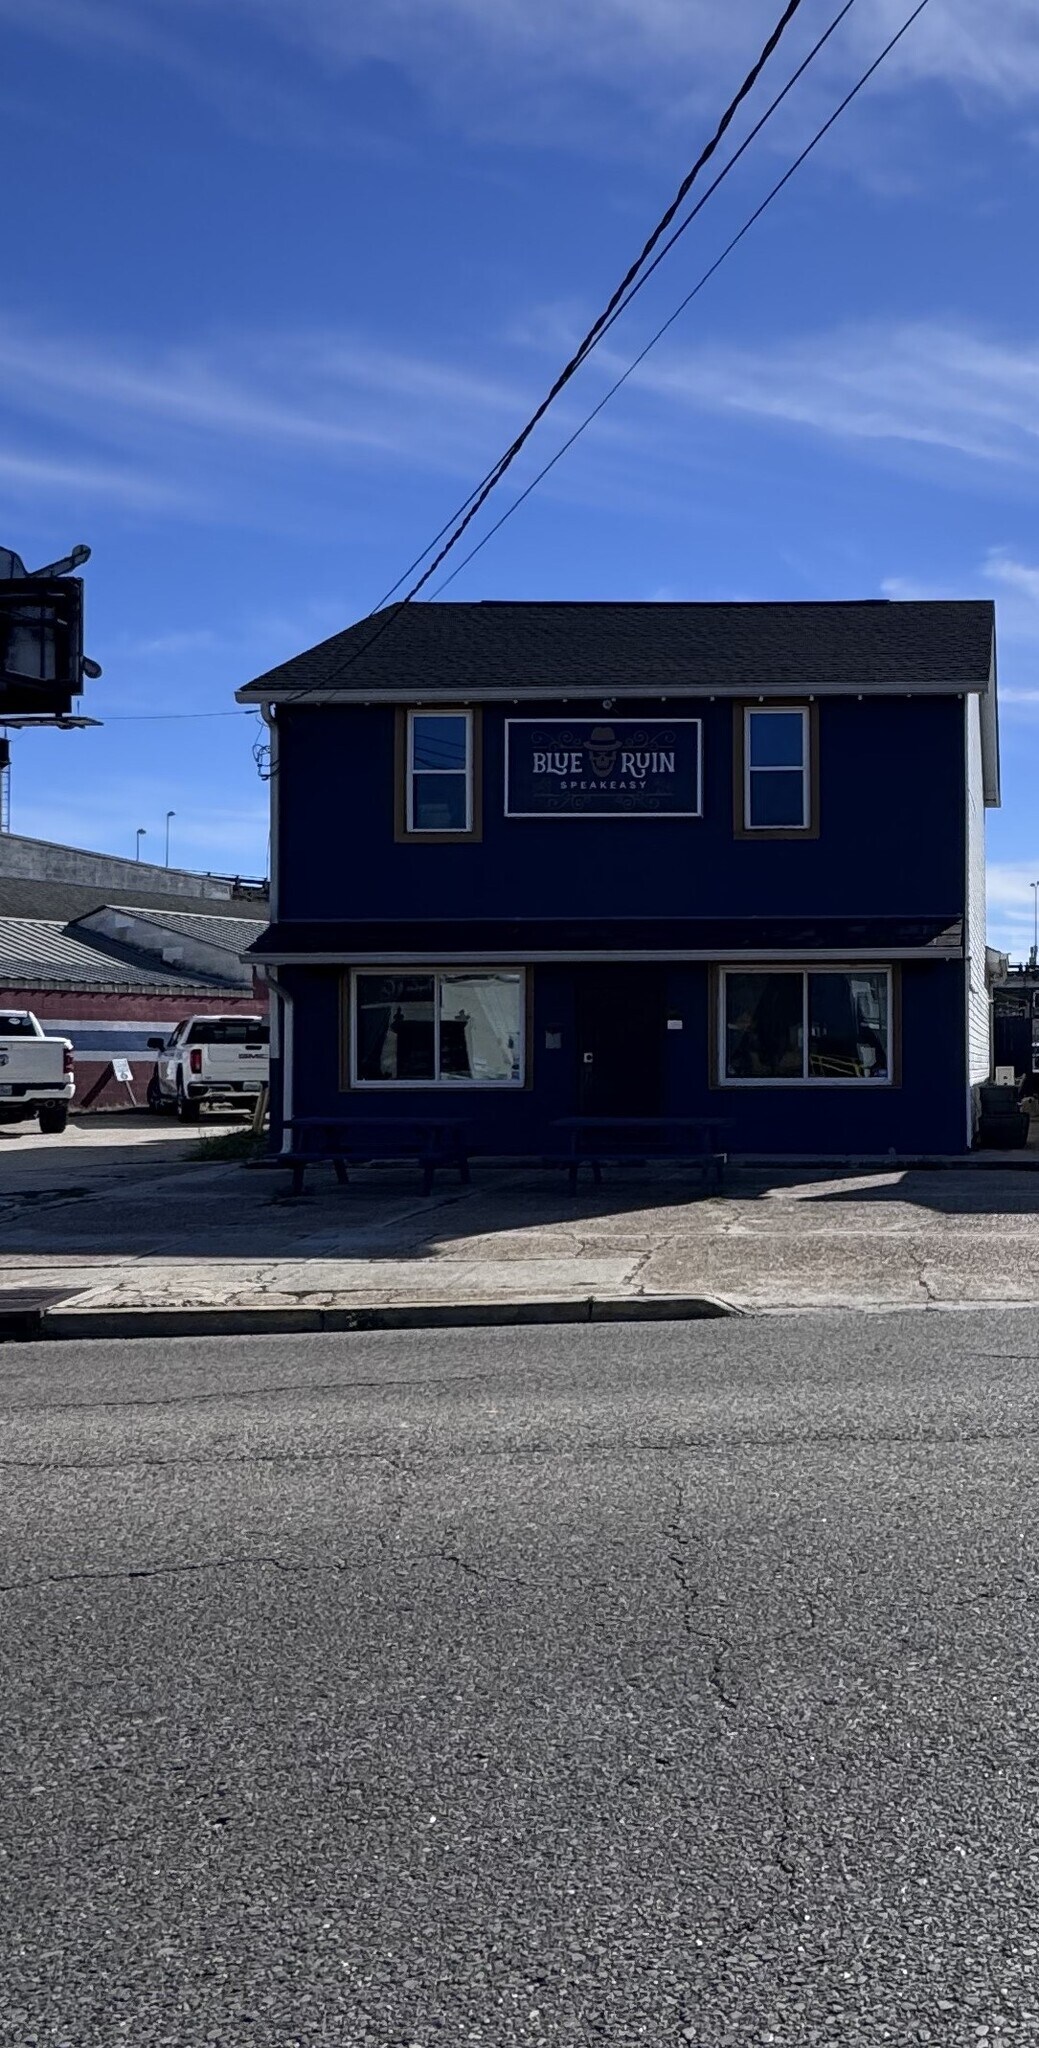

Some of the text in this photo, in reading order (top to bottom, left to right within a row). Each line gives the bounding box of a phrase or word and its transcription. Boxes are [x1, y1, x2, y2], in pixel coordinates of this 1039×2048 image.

[532, 752, 675, 778] BLUE RUIN
[560, 781, 646, 790] SPEAKEASY
